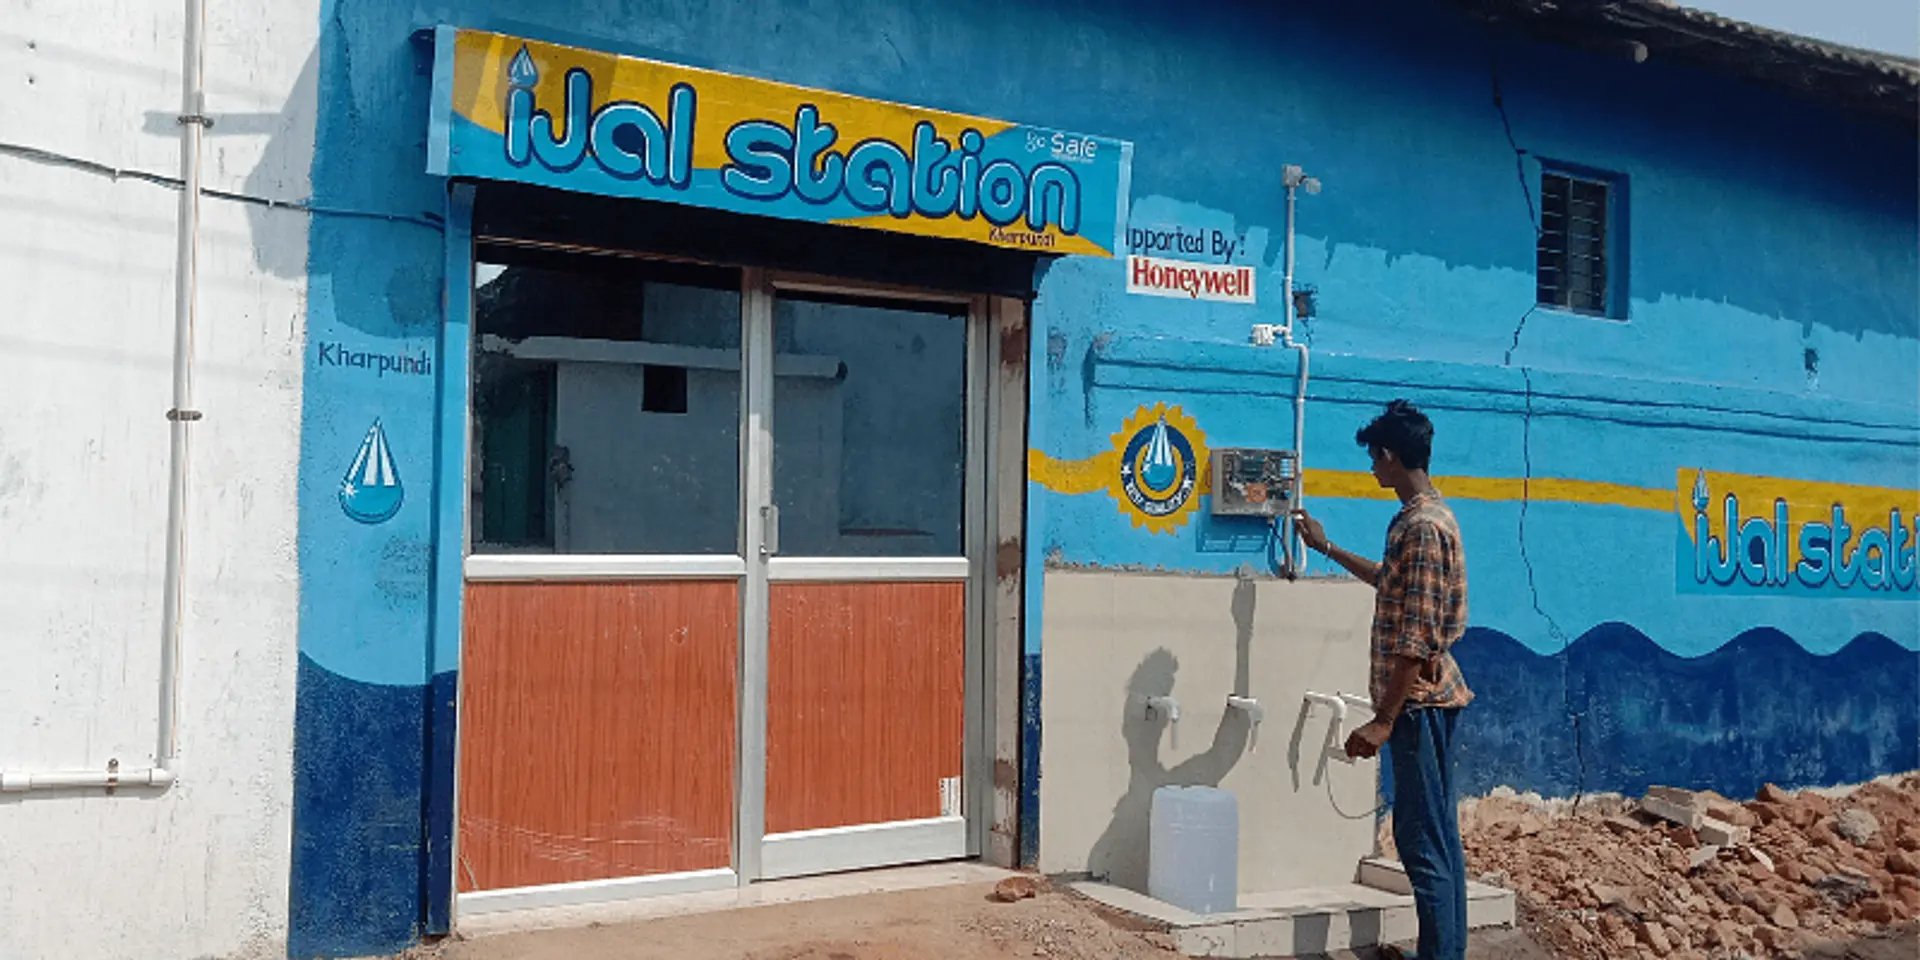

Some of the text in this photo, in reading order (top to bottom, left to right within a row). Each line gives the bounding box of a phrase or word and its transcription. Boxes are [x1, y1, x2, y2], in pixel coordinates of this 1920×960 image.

[1050, 131, 1097, 158] Safe
[719, 103, 1082, 236] station
[1125, 224, 1204, 256] pported
[1132, 257, 1250, 299] Honeywell
[318, 341, 432, 378] Kharpundi
